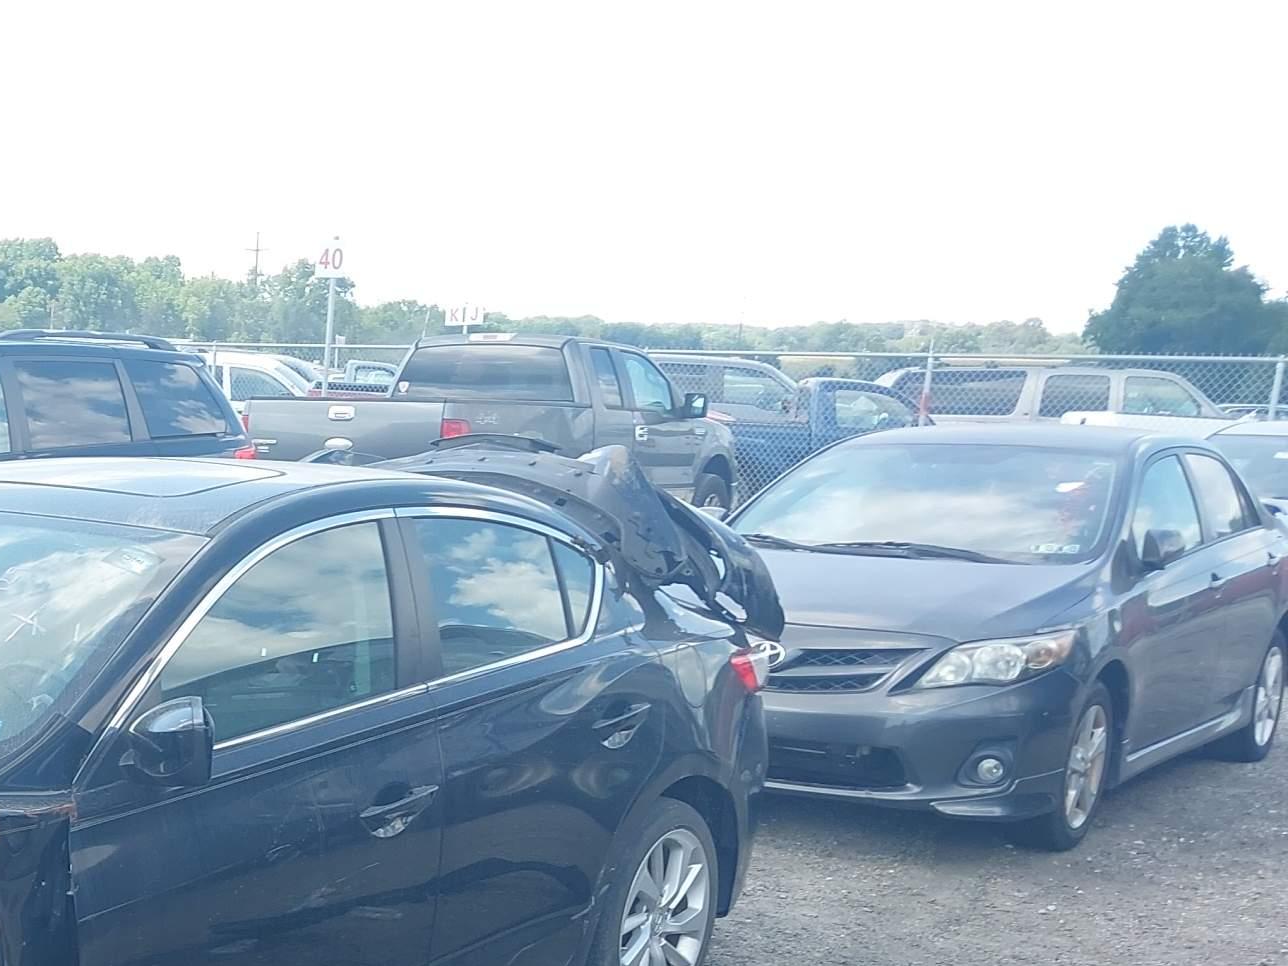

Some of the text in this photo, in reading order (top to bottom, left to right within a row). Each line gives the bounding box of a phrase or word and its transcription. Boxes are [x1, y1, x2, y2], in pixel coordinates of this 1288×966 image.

[319, 248, 343, 270] 40
[450, 307, 479, 322] K J
